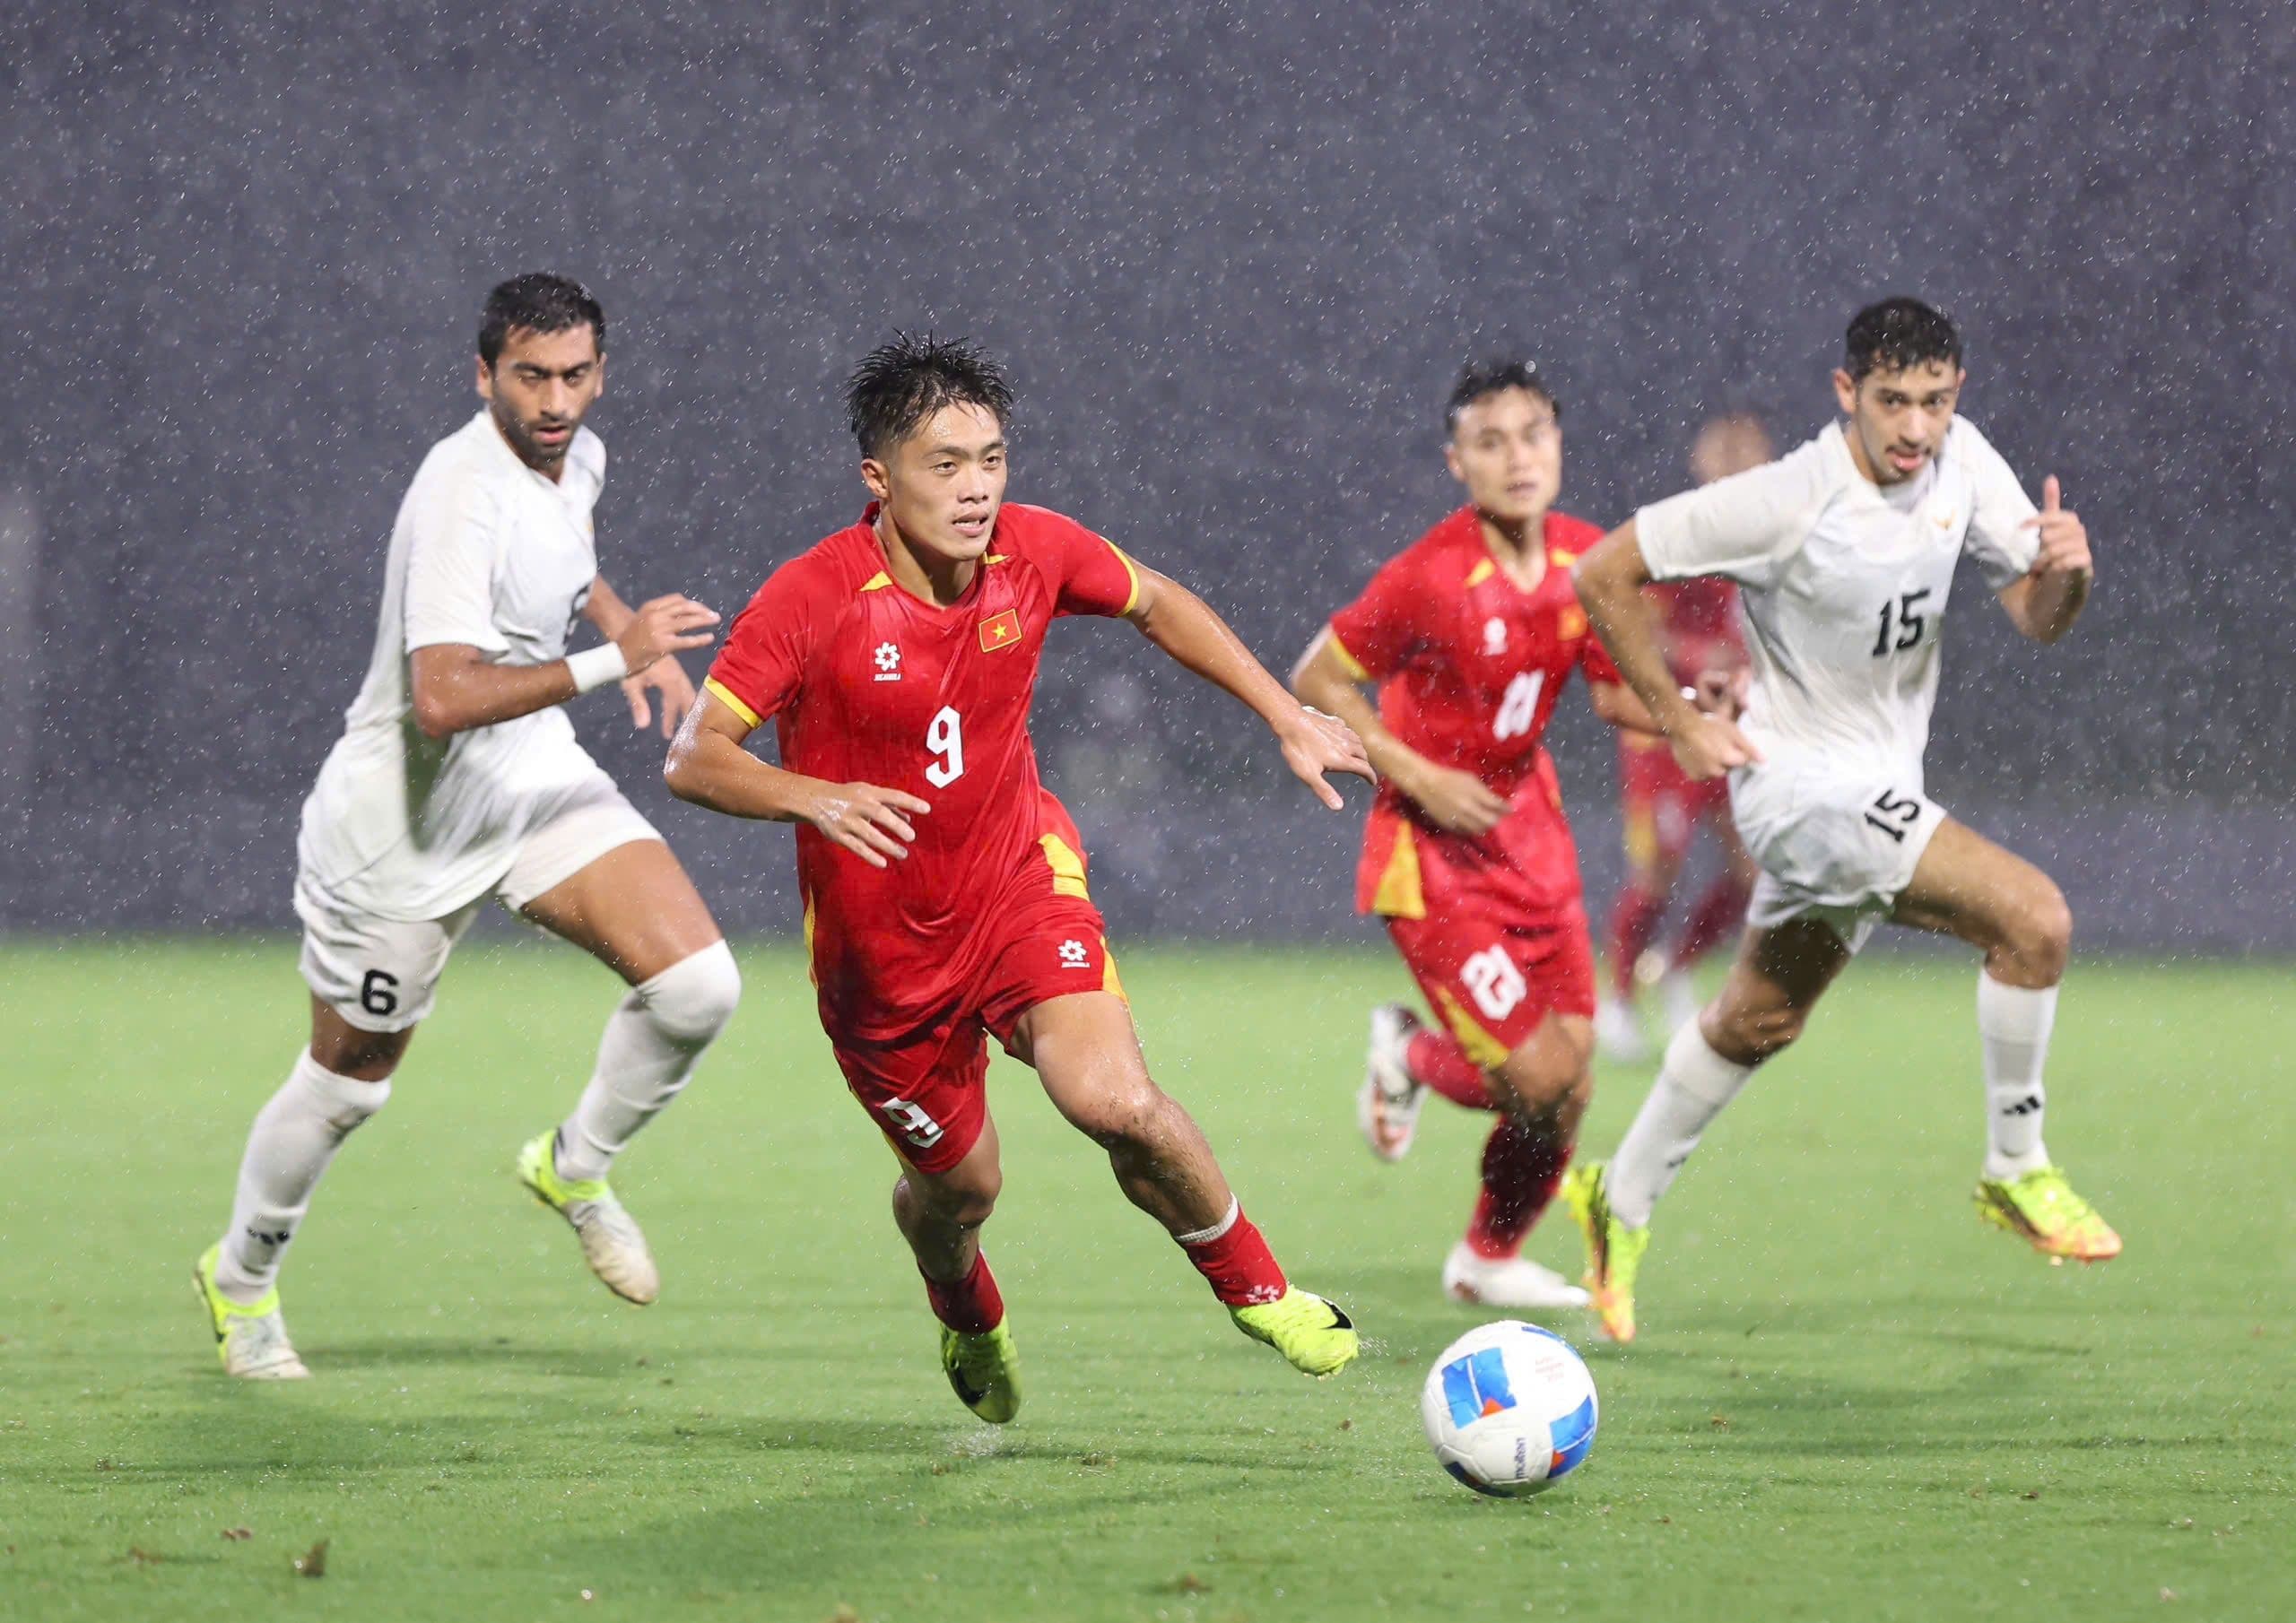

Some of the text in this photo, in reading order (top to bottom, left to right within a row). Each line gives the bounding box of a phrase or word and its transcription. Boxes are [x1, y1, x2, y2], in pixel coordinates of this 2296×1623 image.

[1872, 587, 1930, 656] 15
[926, 705, 964, 789] 9
[1864, 788, 1922, 843] 15
[361, 968, 399, 1016] 6
[881, 1096, 944, 1149] 9
